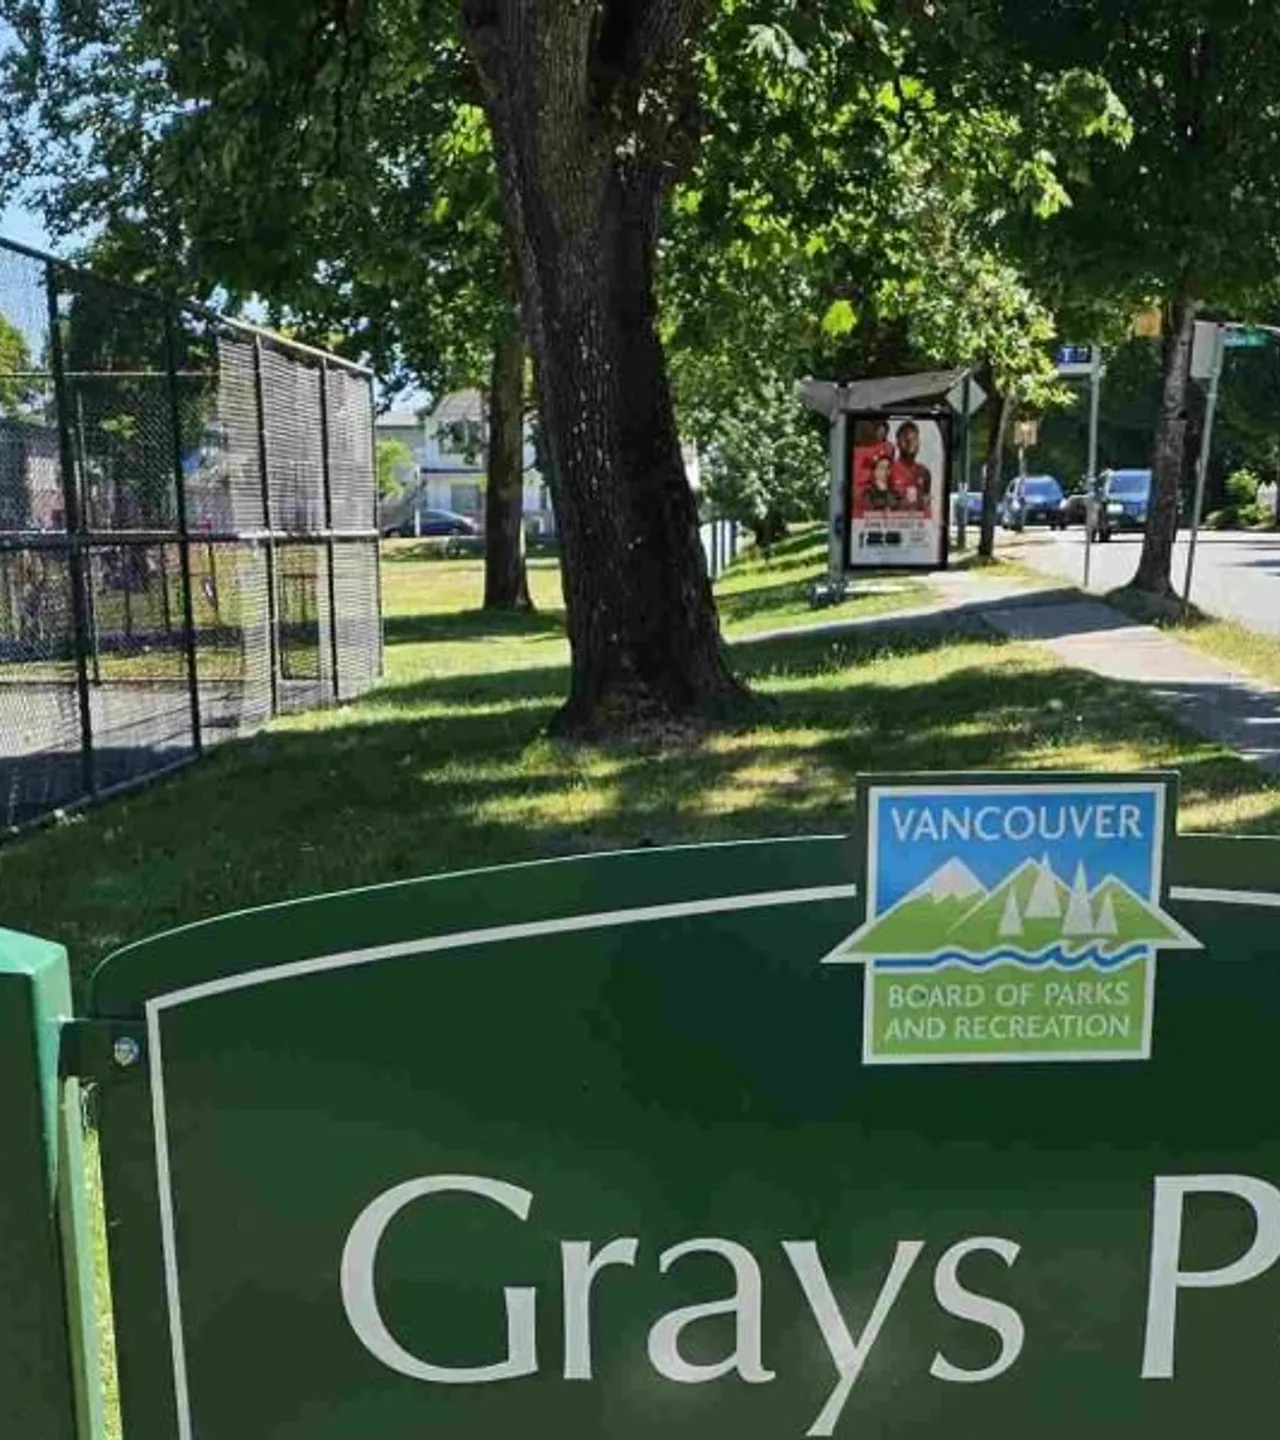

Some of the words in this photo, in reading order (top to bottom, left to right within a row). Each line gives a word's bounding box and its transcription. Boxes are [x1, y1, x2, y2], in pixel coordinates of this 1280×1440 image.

[890, 804, 1145, 842] VANCOUVER
[888, 983, 986, 1010] BOARD
[995, 983, 1037, 1008] OF
[1044, 980, 1131, 1008] PARKS
[884, 1016, 946, 1042] AND
[953, 1013, 1131, 1040] RECREATION
[338, 1173, 1027, 1437] Grays
